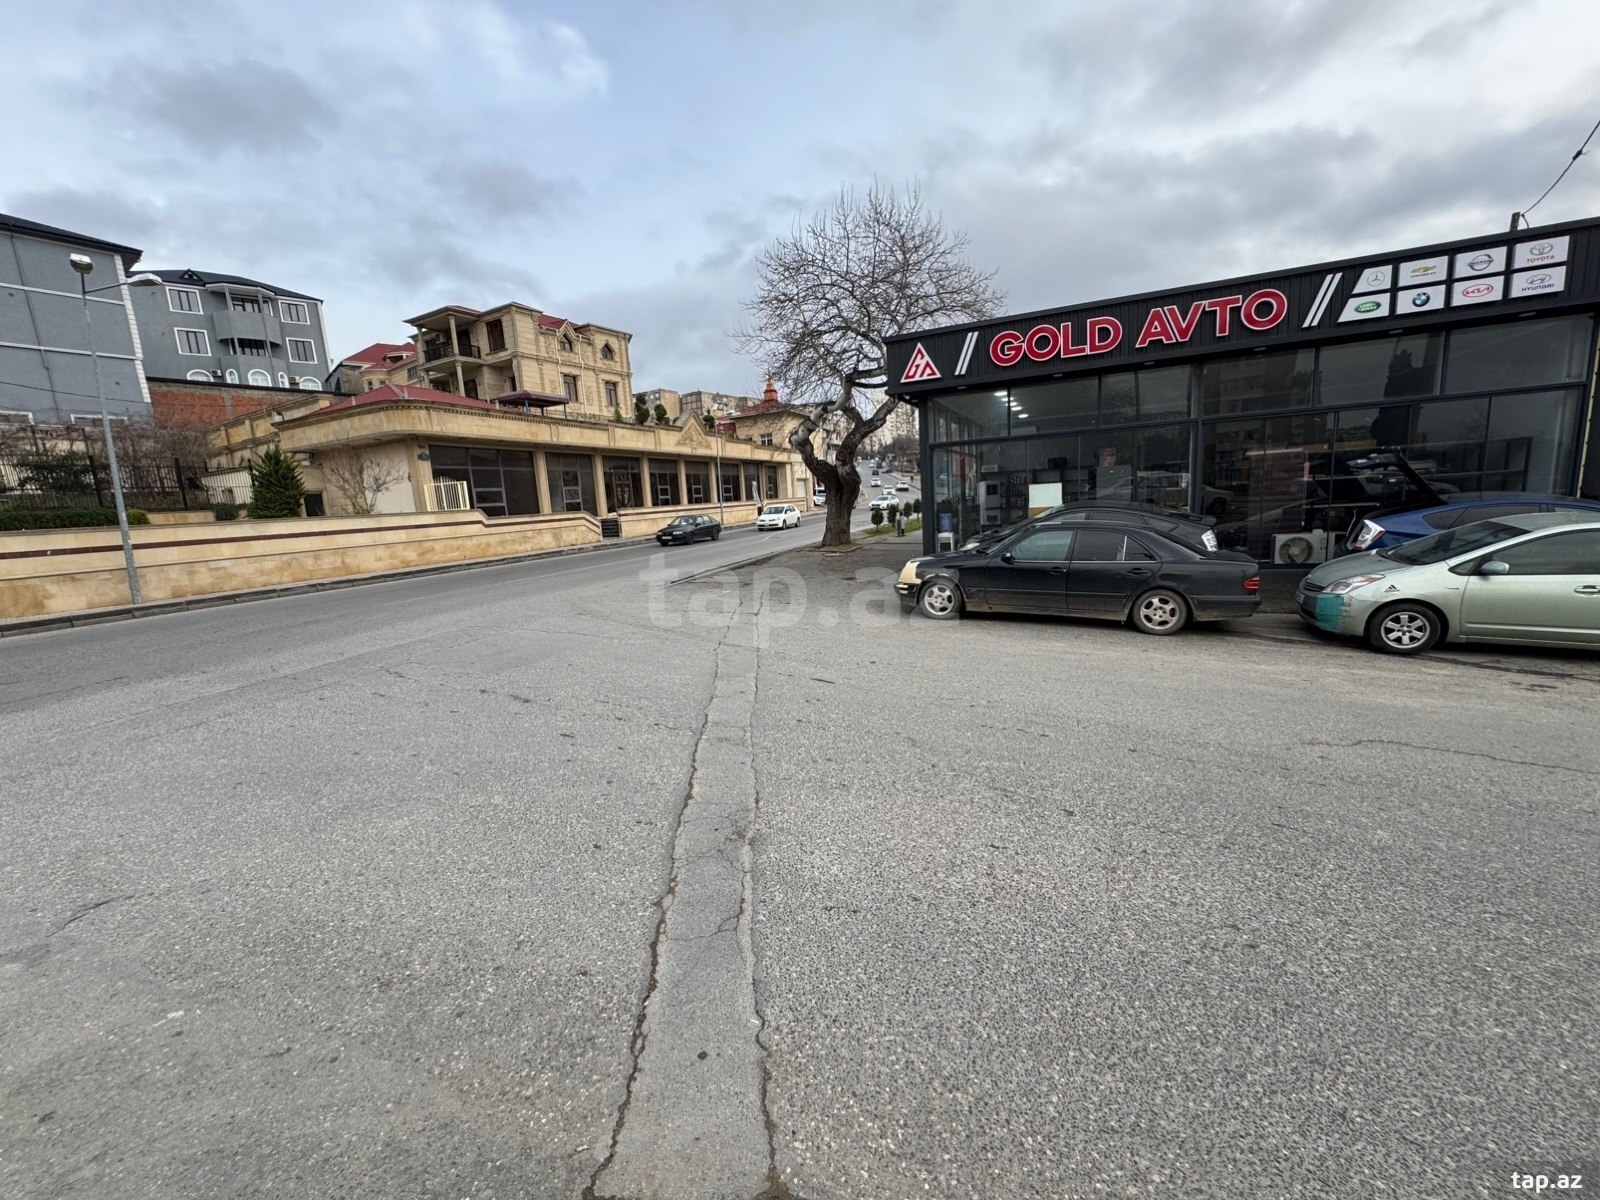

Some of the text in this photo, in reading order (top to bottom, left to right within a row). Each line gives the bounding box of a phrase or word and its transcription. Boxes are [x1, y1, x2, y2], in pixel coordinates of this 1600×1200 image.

[1526, 254, 1555, 263] TOYOTA
[1521, 283, 1555, 292] HYUNDAI
[989, 288, 1288, 367] GOLD AVTO
